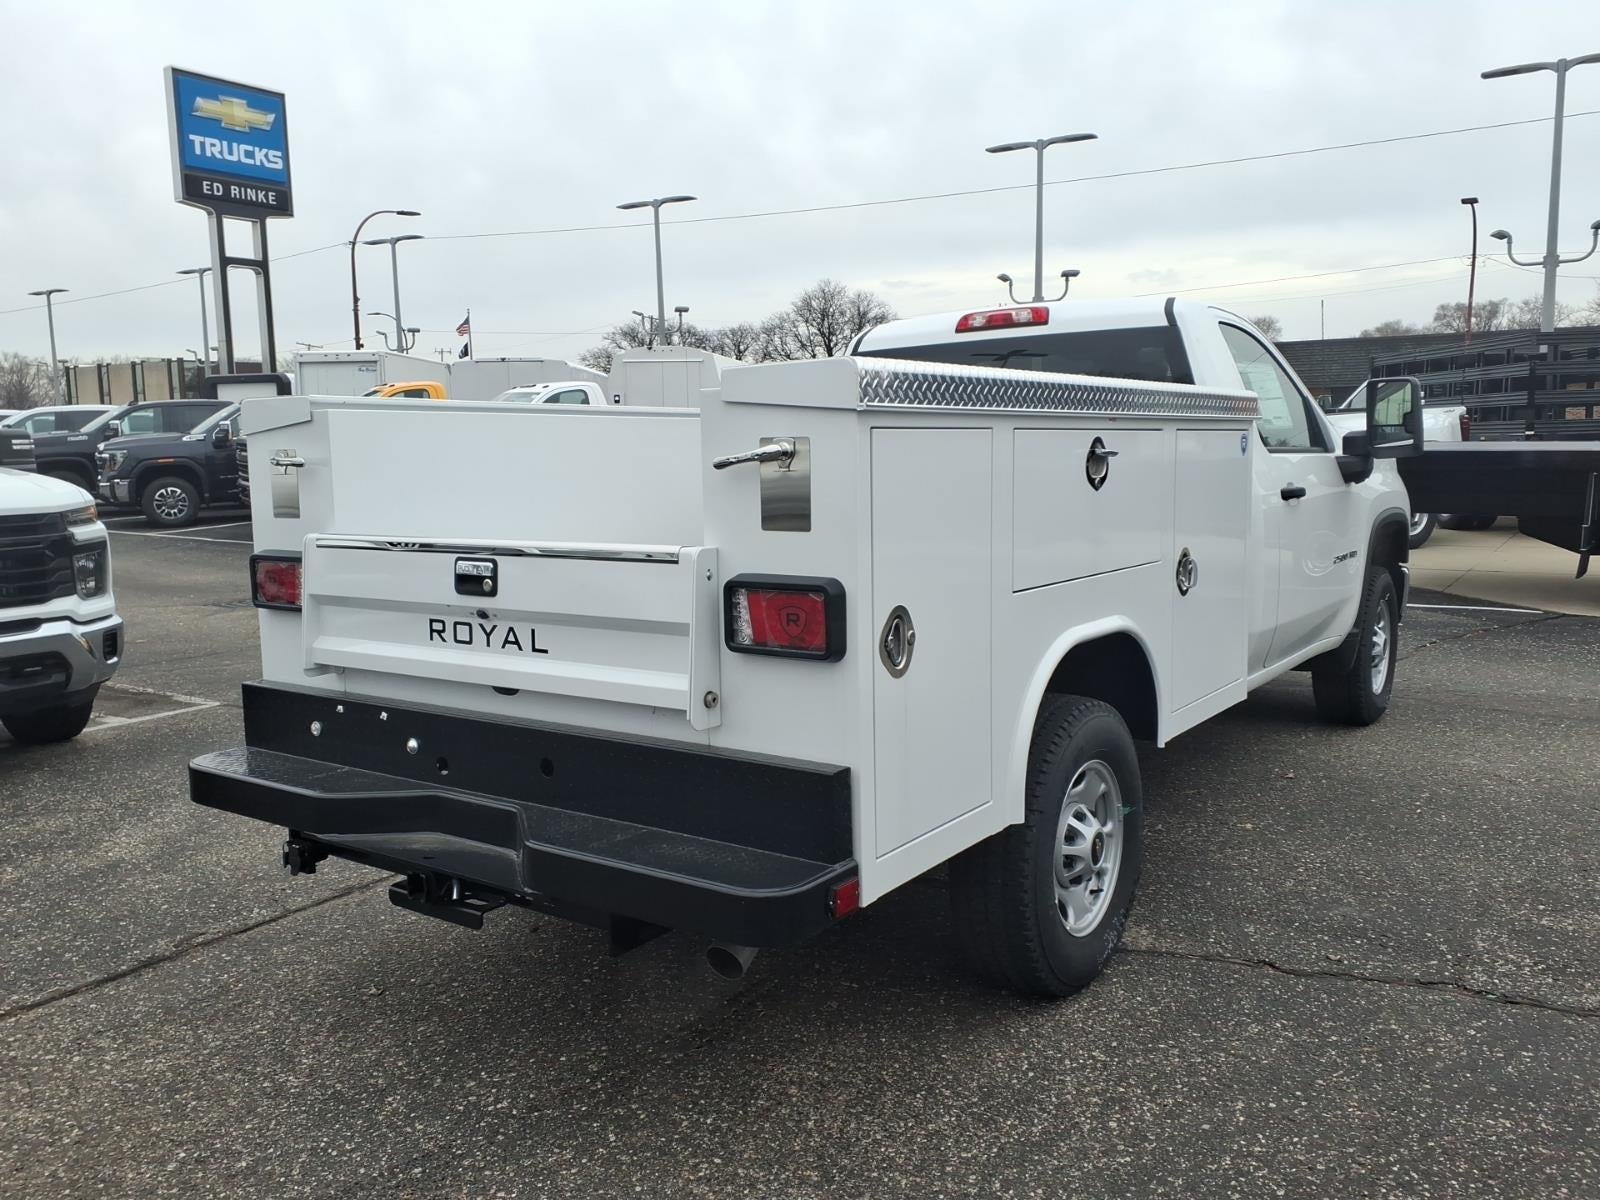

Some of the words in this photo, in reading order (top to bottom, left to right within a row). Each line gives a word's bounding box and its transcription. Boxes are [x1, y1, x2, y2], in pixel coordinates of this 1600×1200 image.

[188, 134, 283, 170] TRUCKS
[202, 180, 223, 196] ED
[231, 185, 277, 205] RINKE
[786, 612, 801, 627] R
[428, 618, 549, 654] ROYAL
